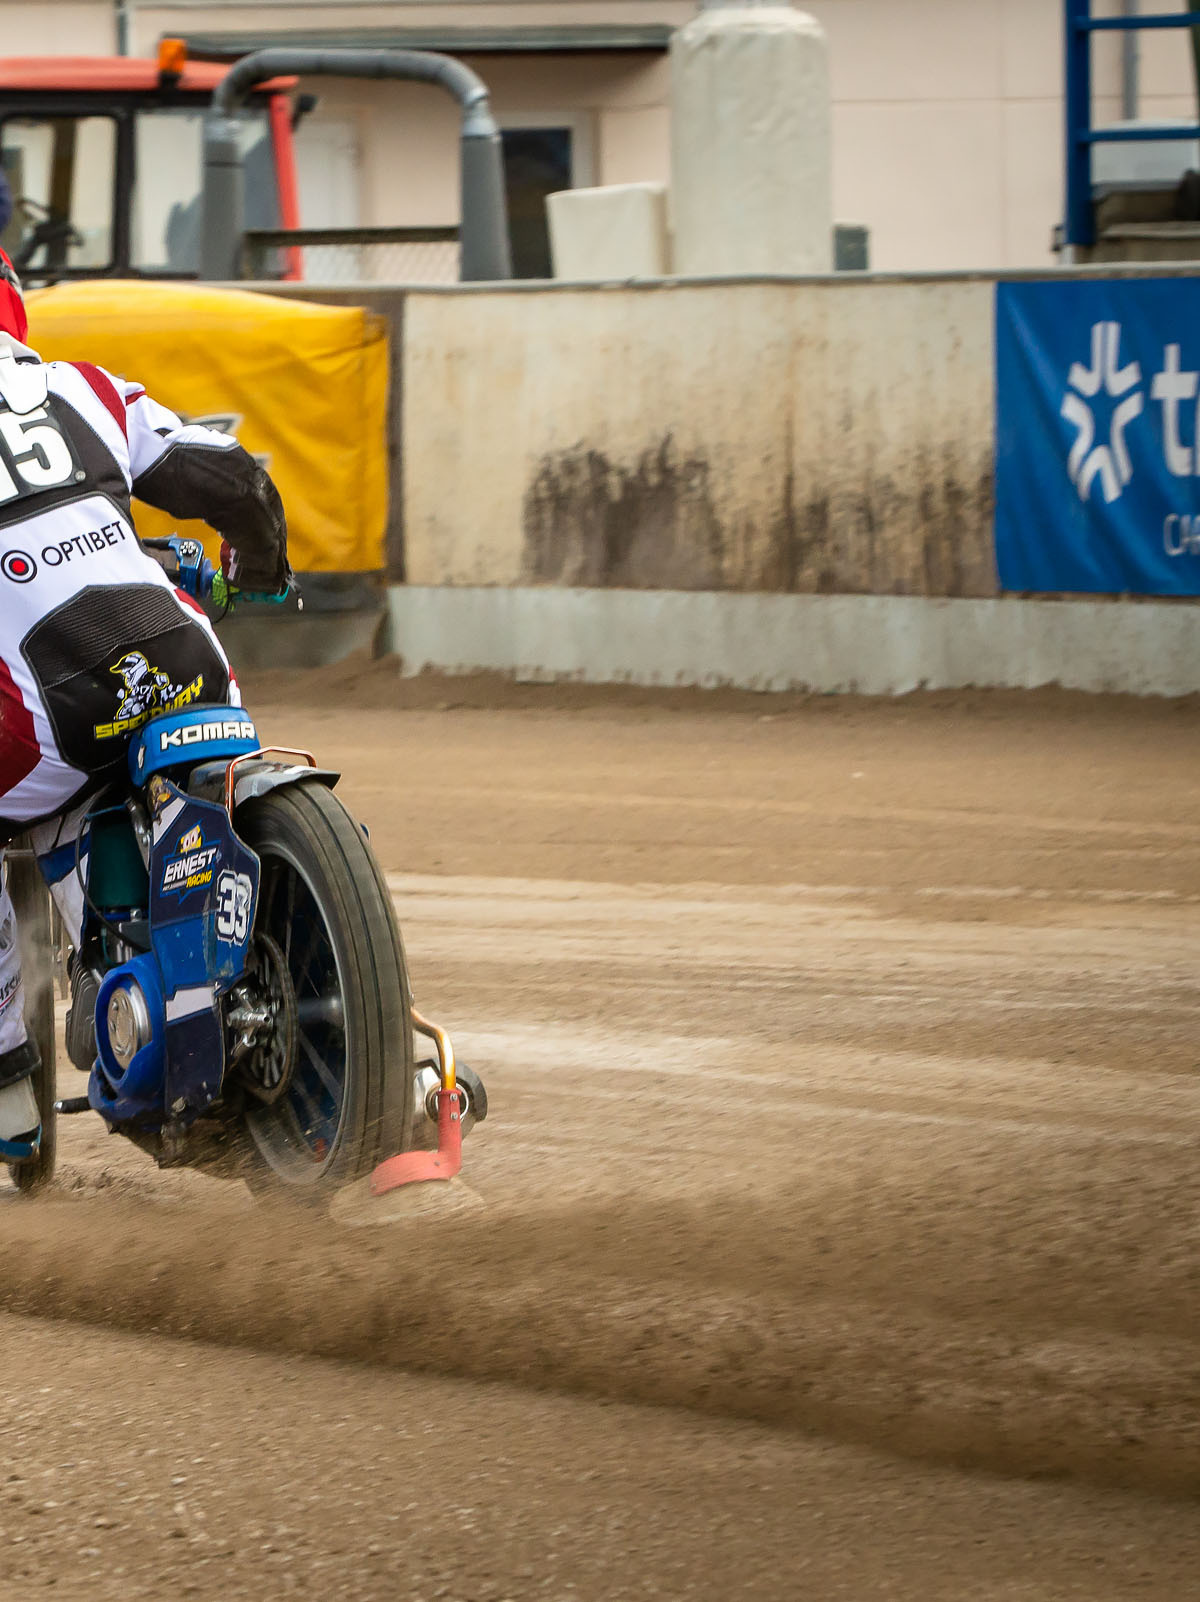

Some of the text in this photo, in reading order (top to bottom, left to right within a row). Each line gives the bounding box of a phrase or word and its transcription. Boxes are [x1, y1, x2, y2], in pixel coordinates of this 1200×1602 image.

[41, 520, 127, 567] OPTIBET
[160, 721, 256, 751] KOMAR
[163, 847, 217, 884] ERNEST
[186, 870, 213, 889] RACING
